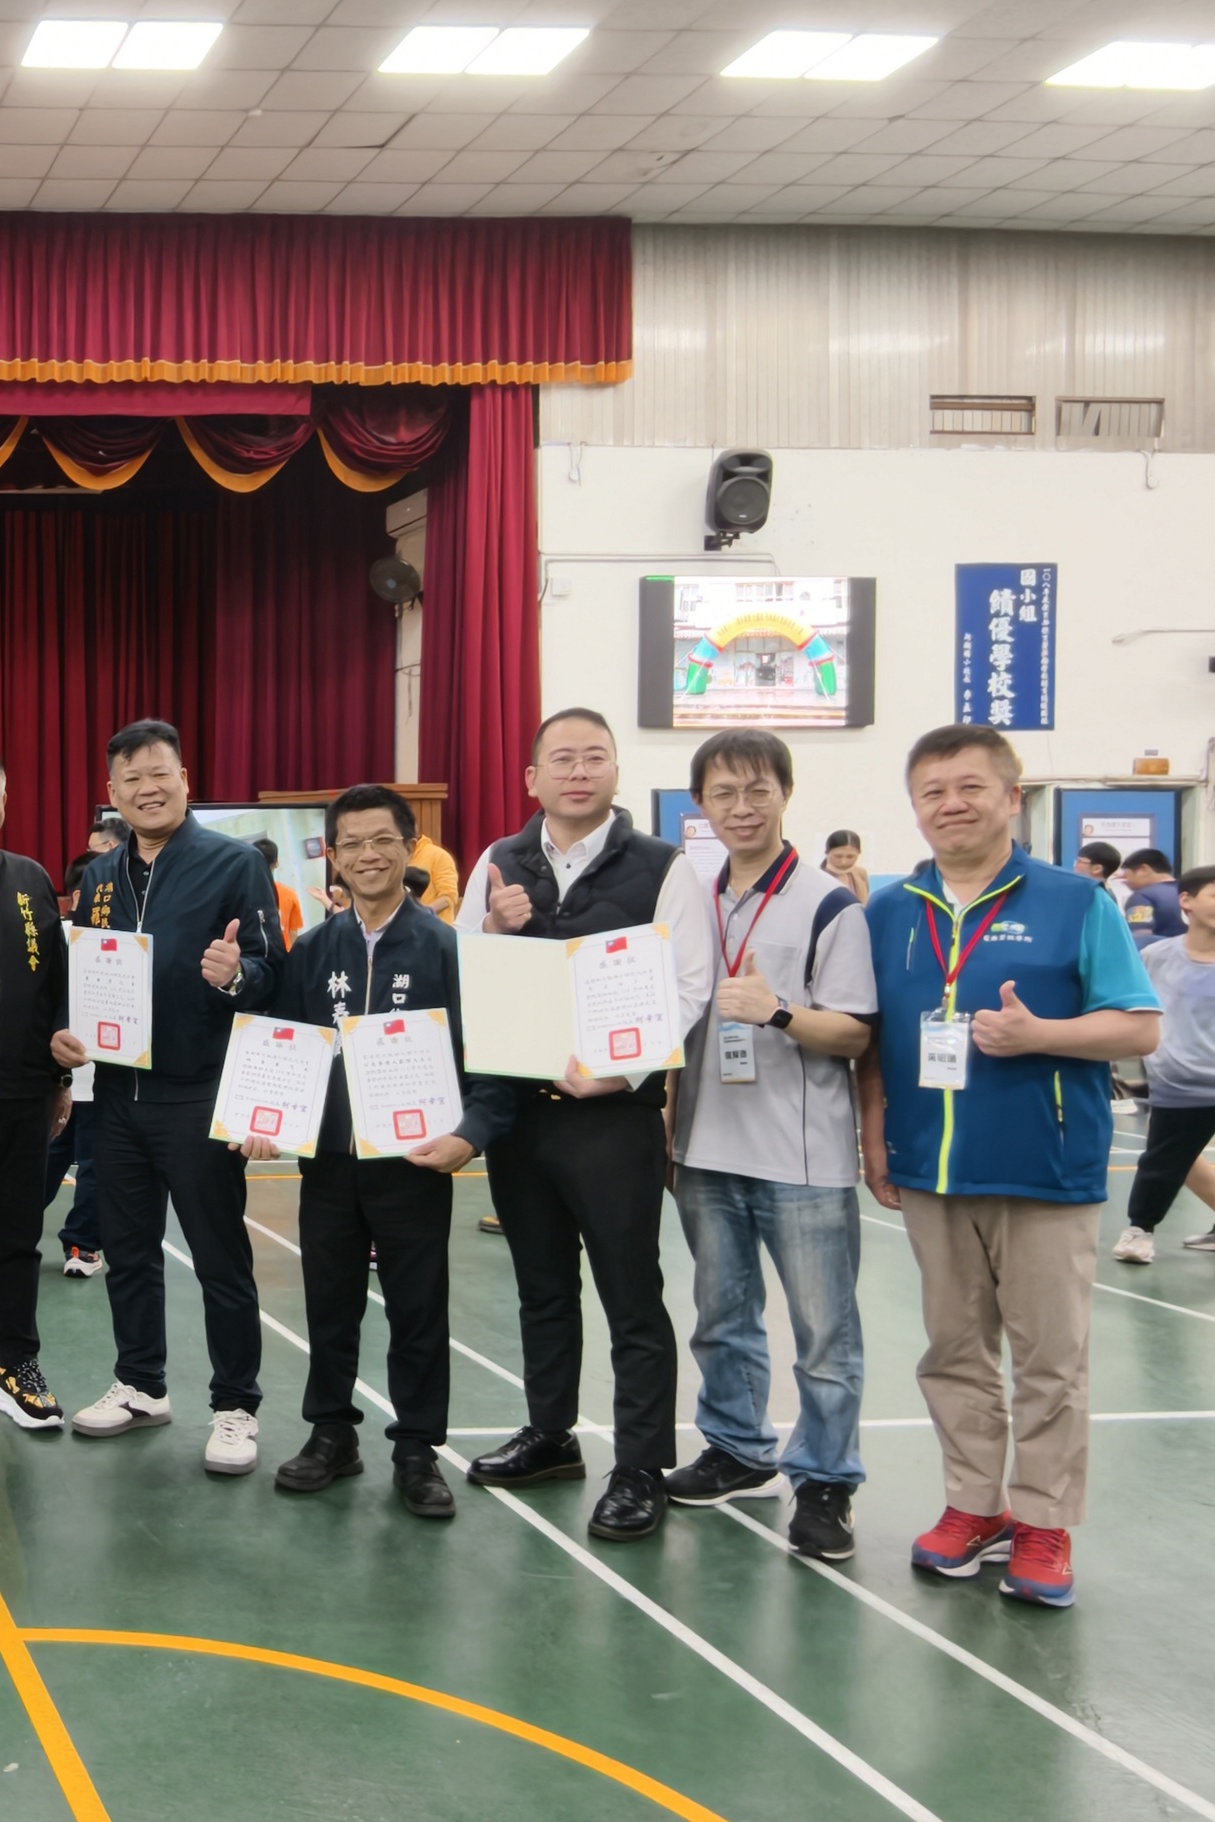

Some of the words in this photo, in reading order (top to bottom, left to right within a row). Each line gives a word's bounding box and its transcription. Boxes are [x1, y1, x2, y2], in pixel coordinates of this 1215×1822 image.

[1019, 568, 1038, 622] 國小組
[987, 588, 1017, 726] 績優學校獎
[392, 973, 410, 1014] 湖口
